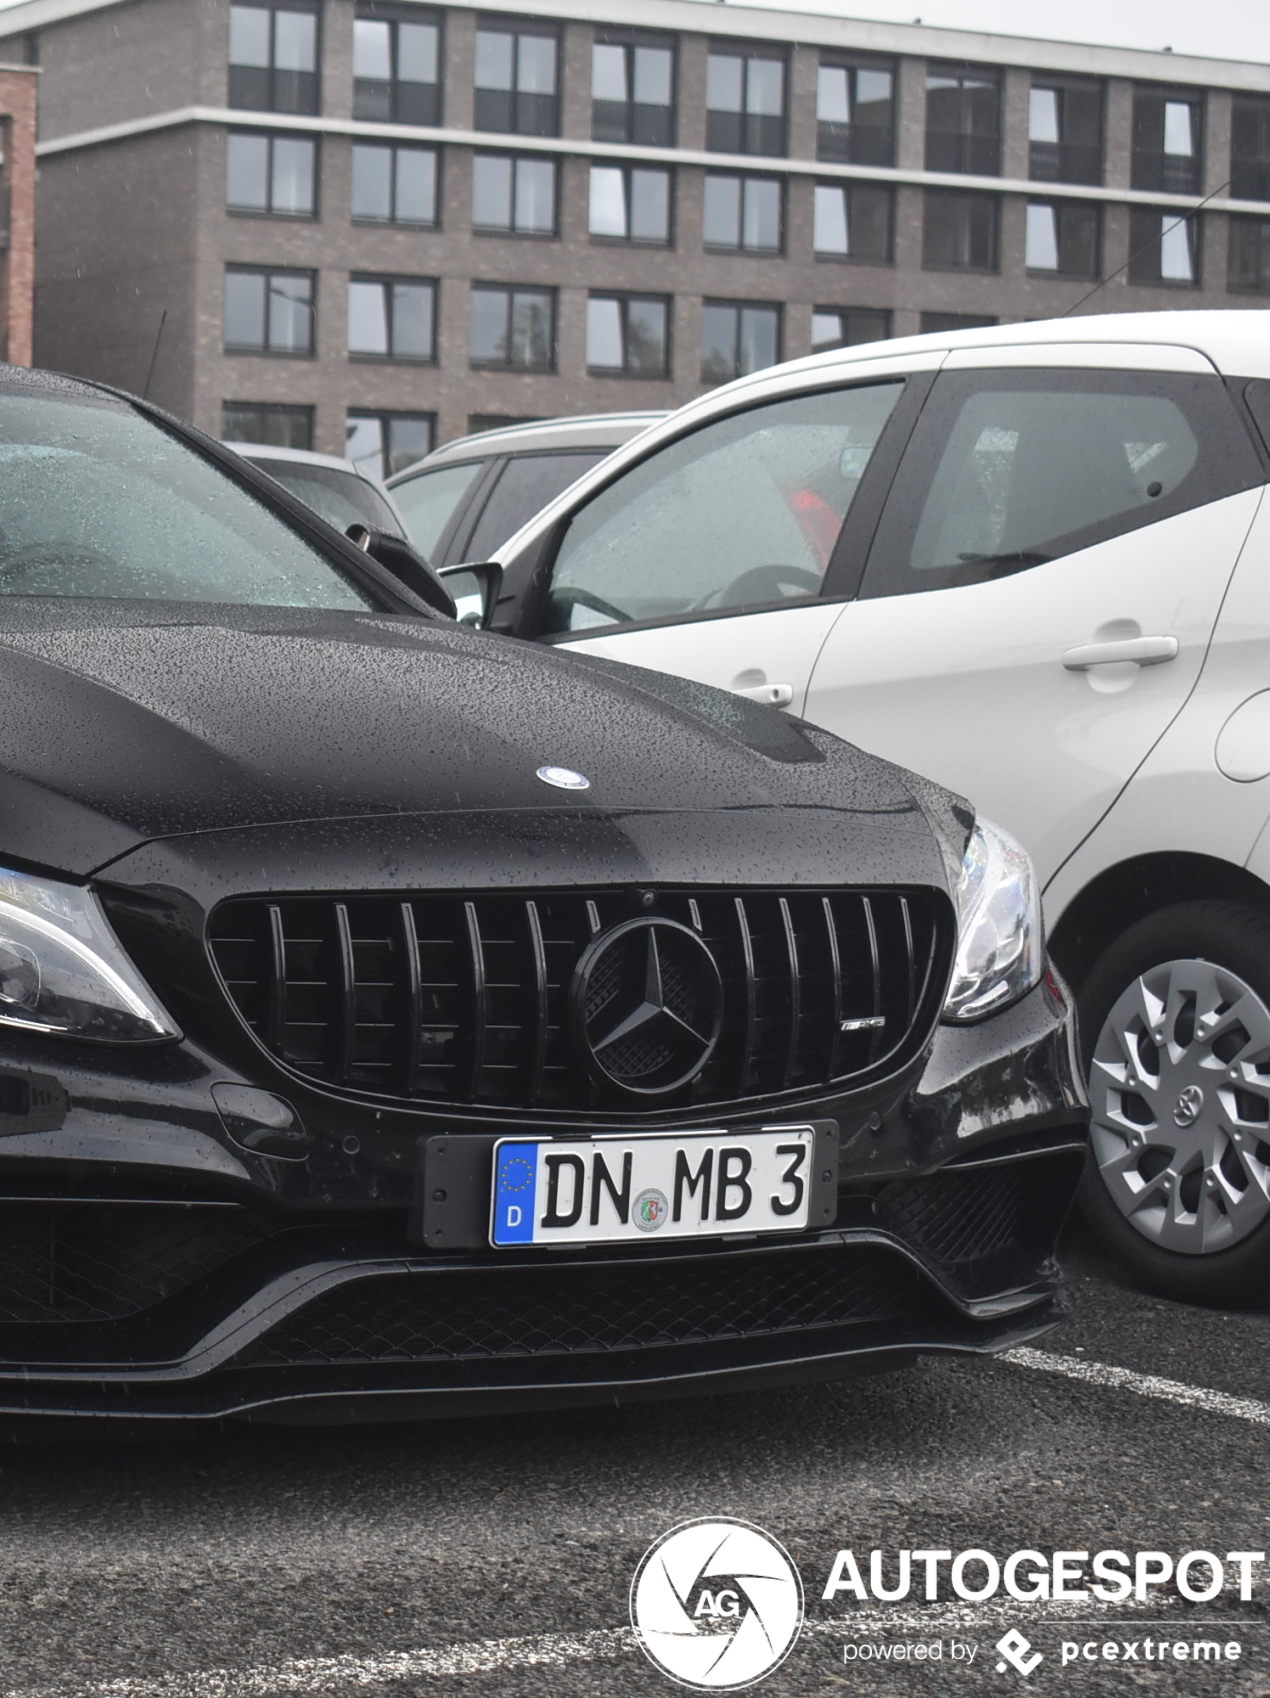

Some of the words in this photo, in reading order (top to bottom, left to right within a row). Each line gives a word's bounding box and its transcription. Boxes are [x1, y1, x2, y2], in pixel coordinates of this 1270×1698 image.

[540, 1150, 633, 1228] DN
[672, 1147, 752, 1222] MB
[770, 1143, 807, 1216] 3
[506, 1205, 522, 1227] D
